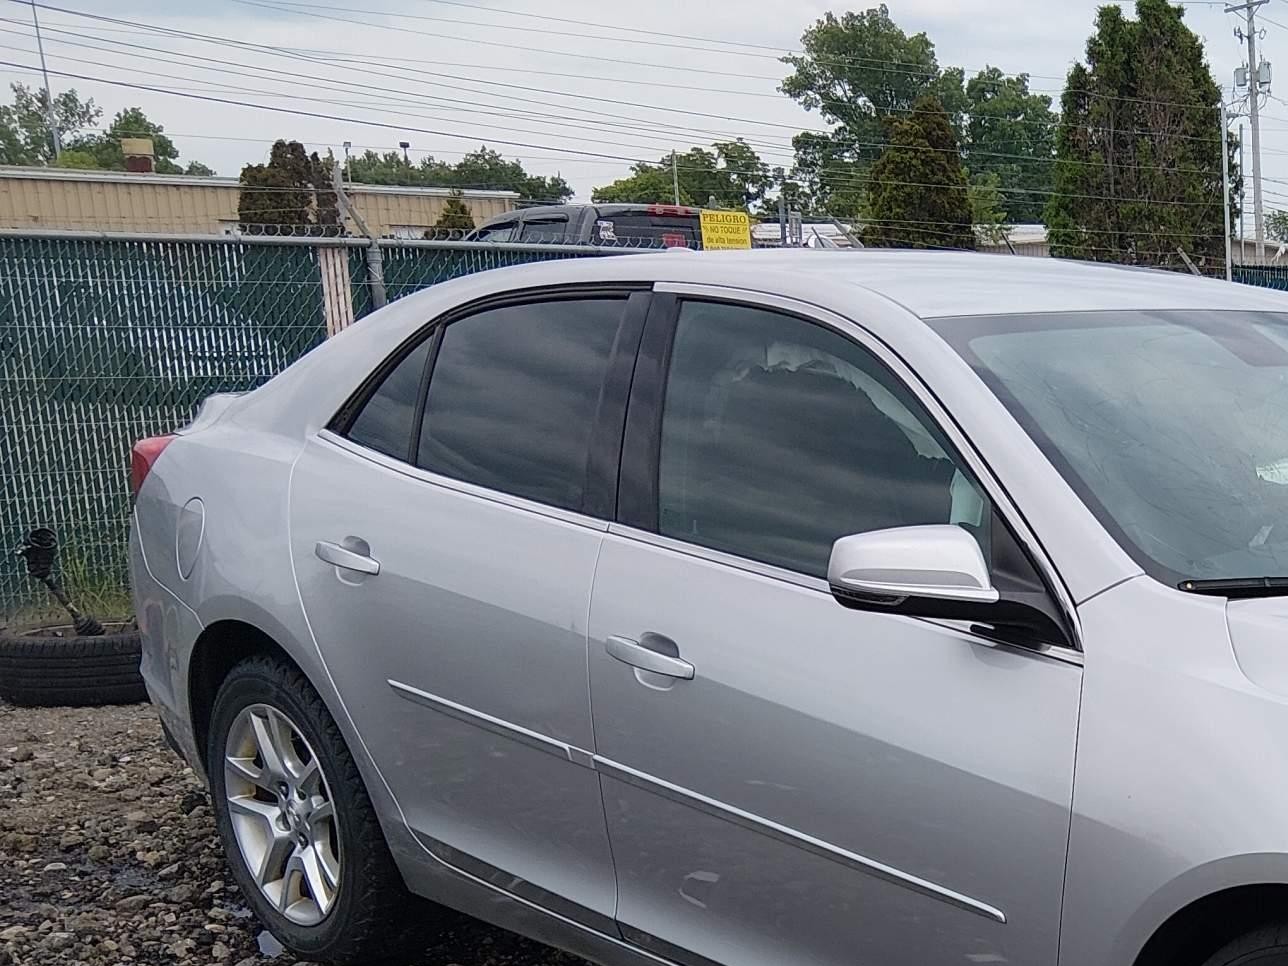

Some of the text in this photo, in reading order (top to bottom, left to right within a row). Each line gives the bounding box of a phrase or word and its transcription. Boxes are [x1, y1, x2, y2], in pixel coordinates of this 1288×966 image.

[703, 213, 746, 223] PELIGRO
[710, 225, 742, 234] NO TOQUE
